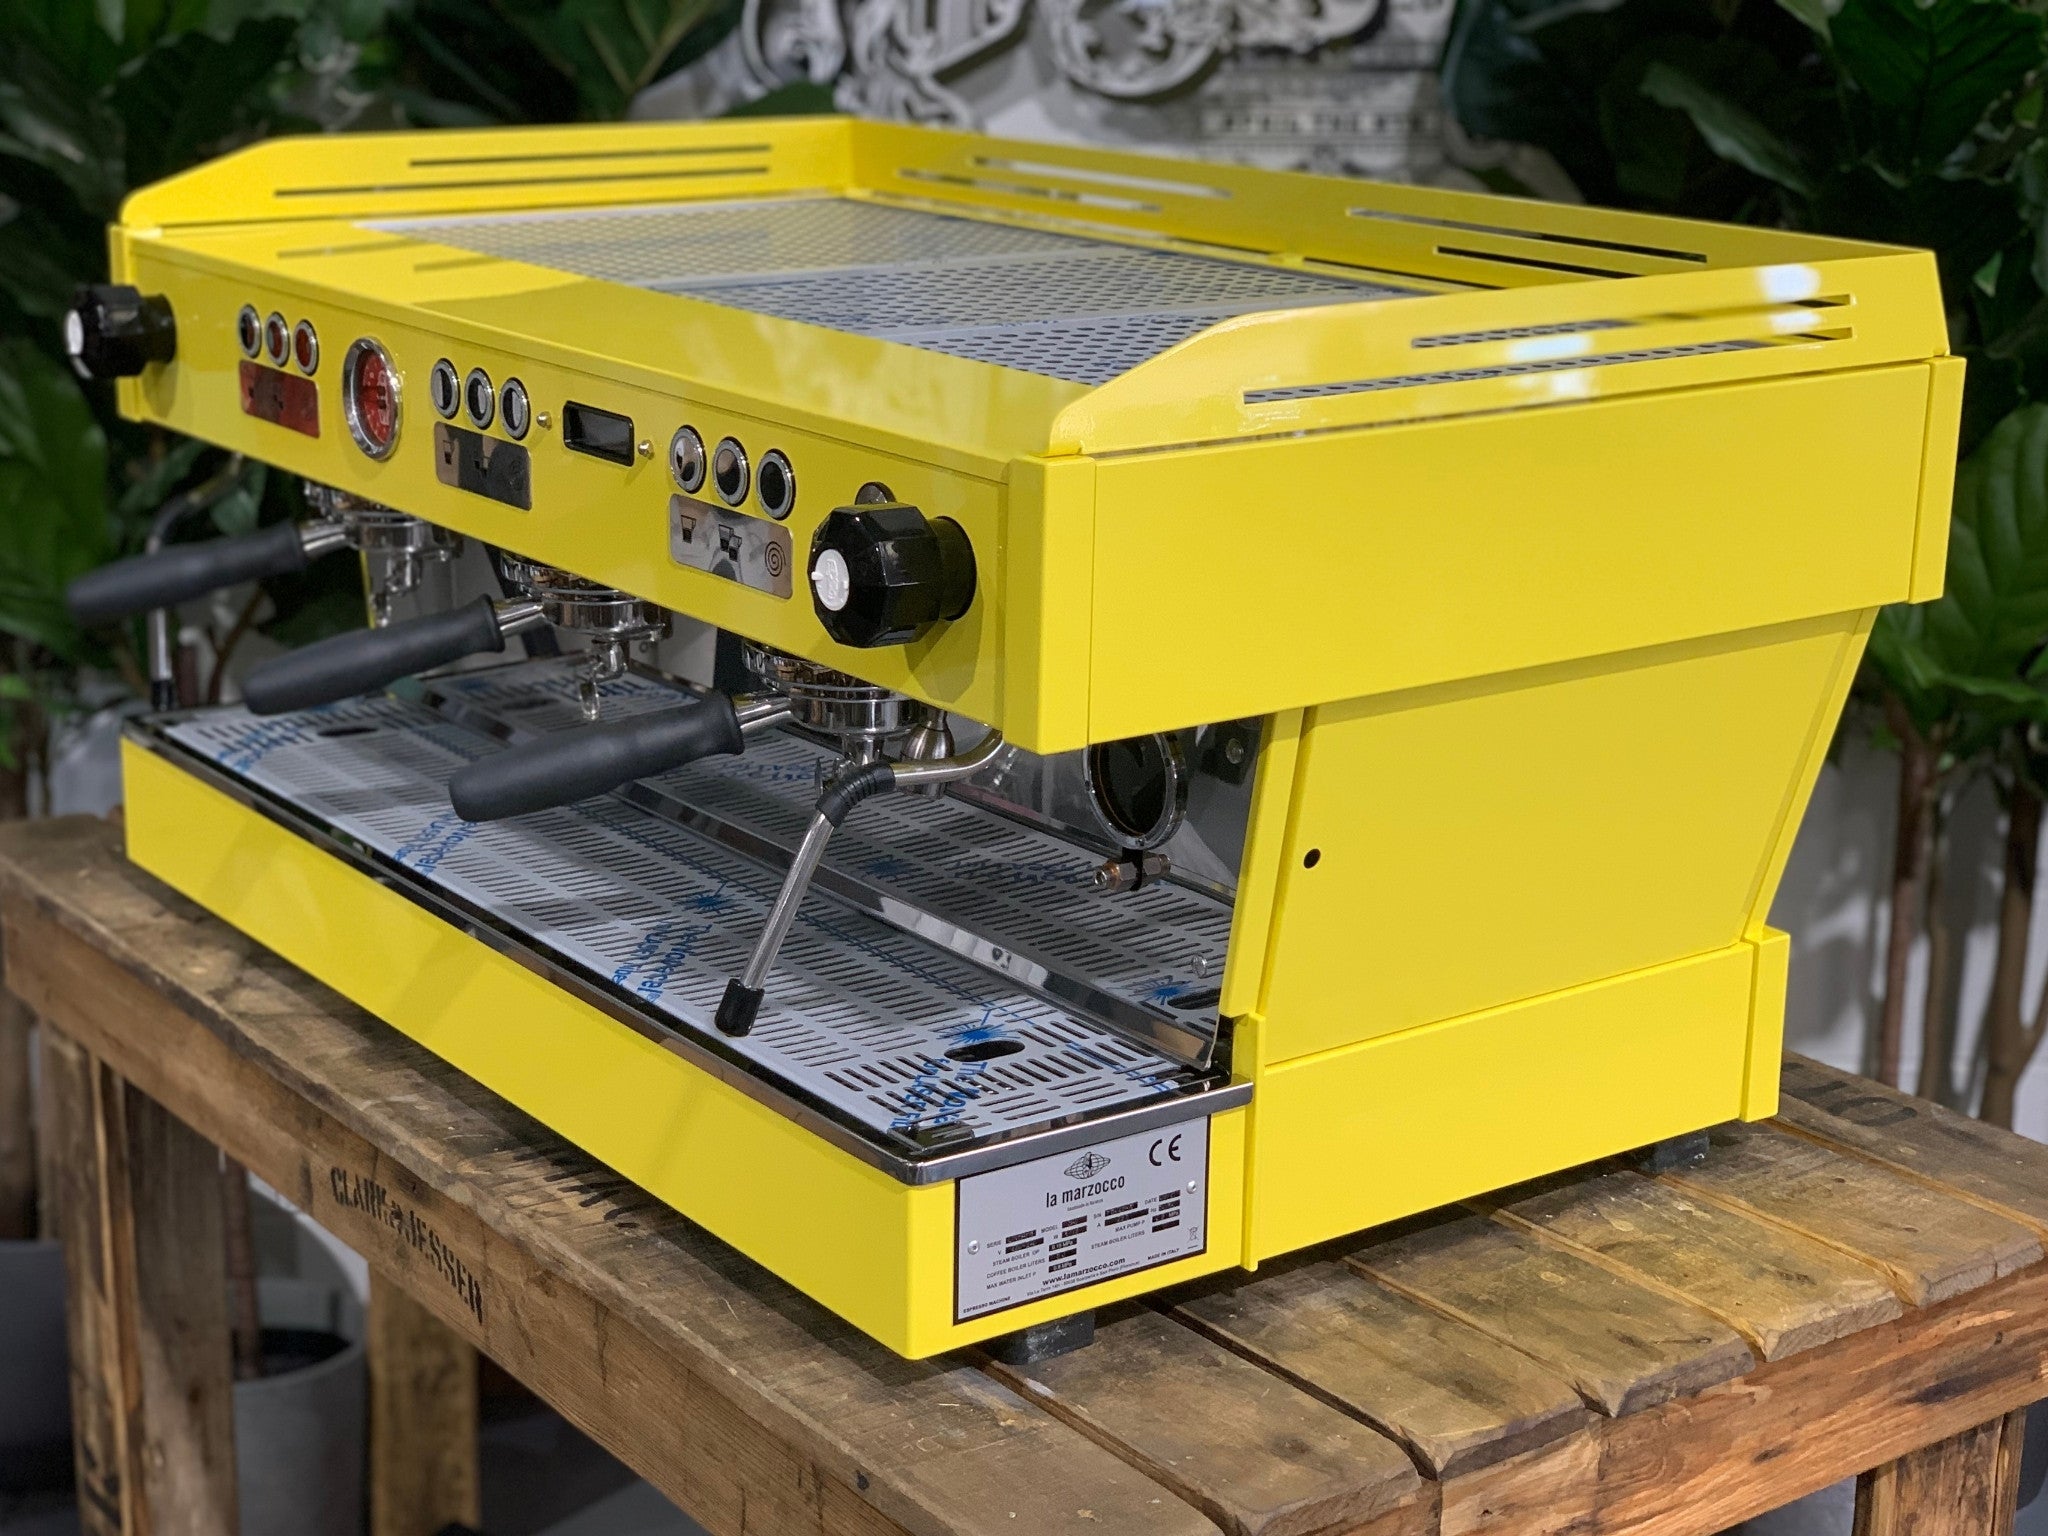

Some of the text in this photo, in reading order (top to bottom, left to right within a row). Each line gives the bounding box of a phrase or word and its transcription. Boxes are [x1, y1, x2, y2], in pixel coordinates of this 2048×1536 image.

[1046, 1192, 1057, 1208] la
[1062, 1176, 1125, 1204] marzocco
[1042, 1257, 1126, 1286] www.lamarzocco.com
